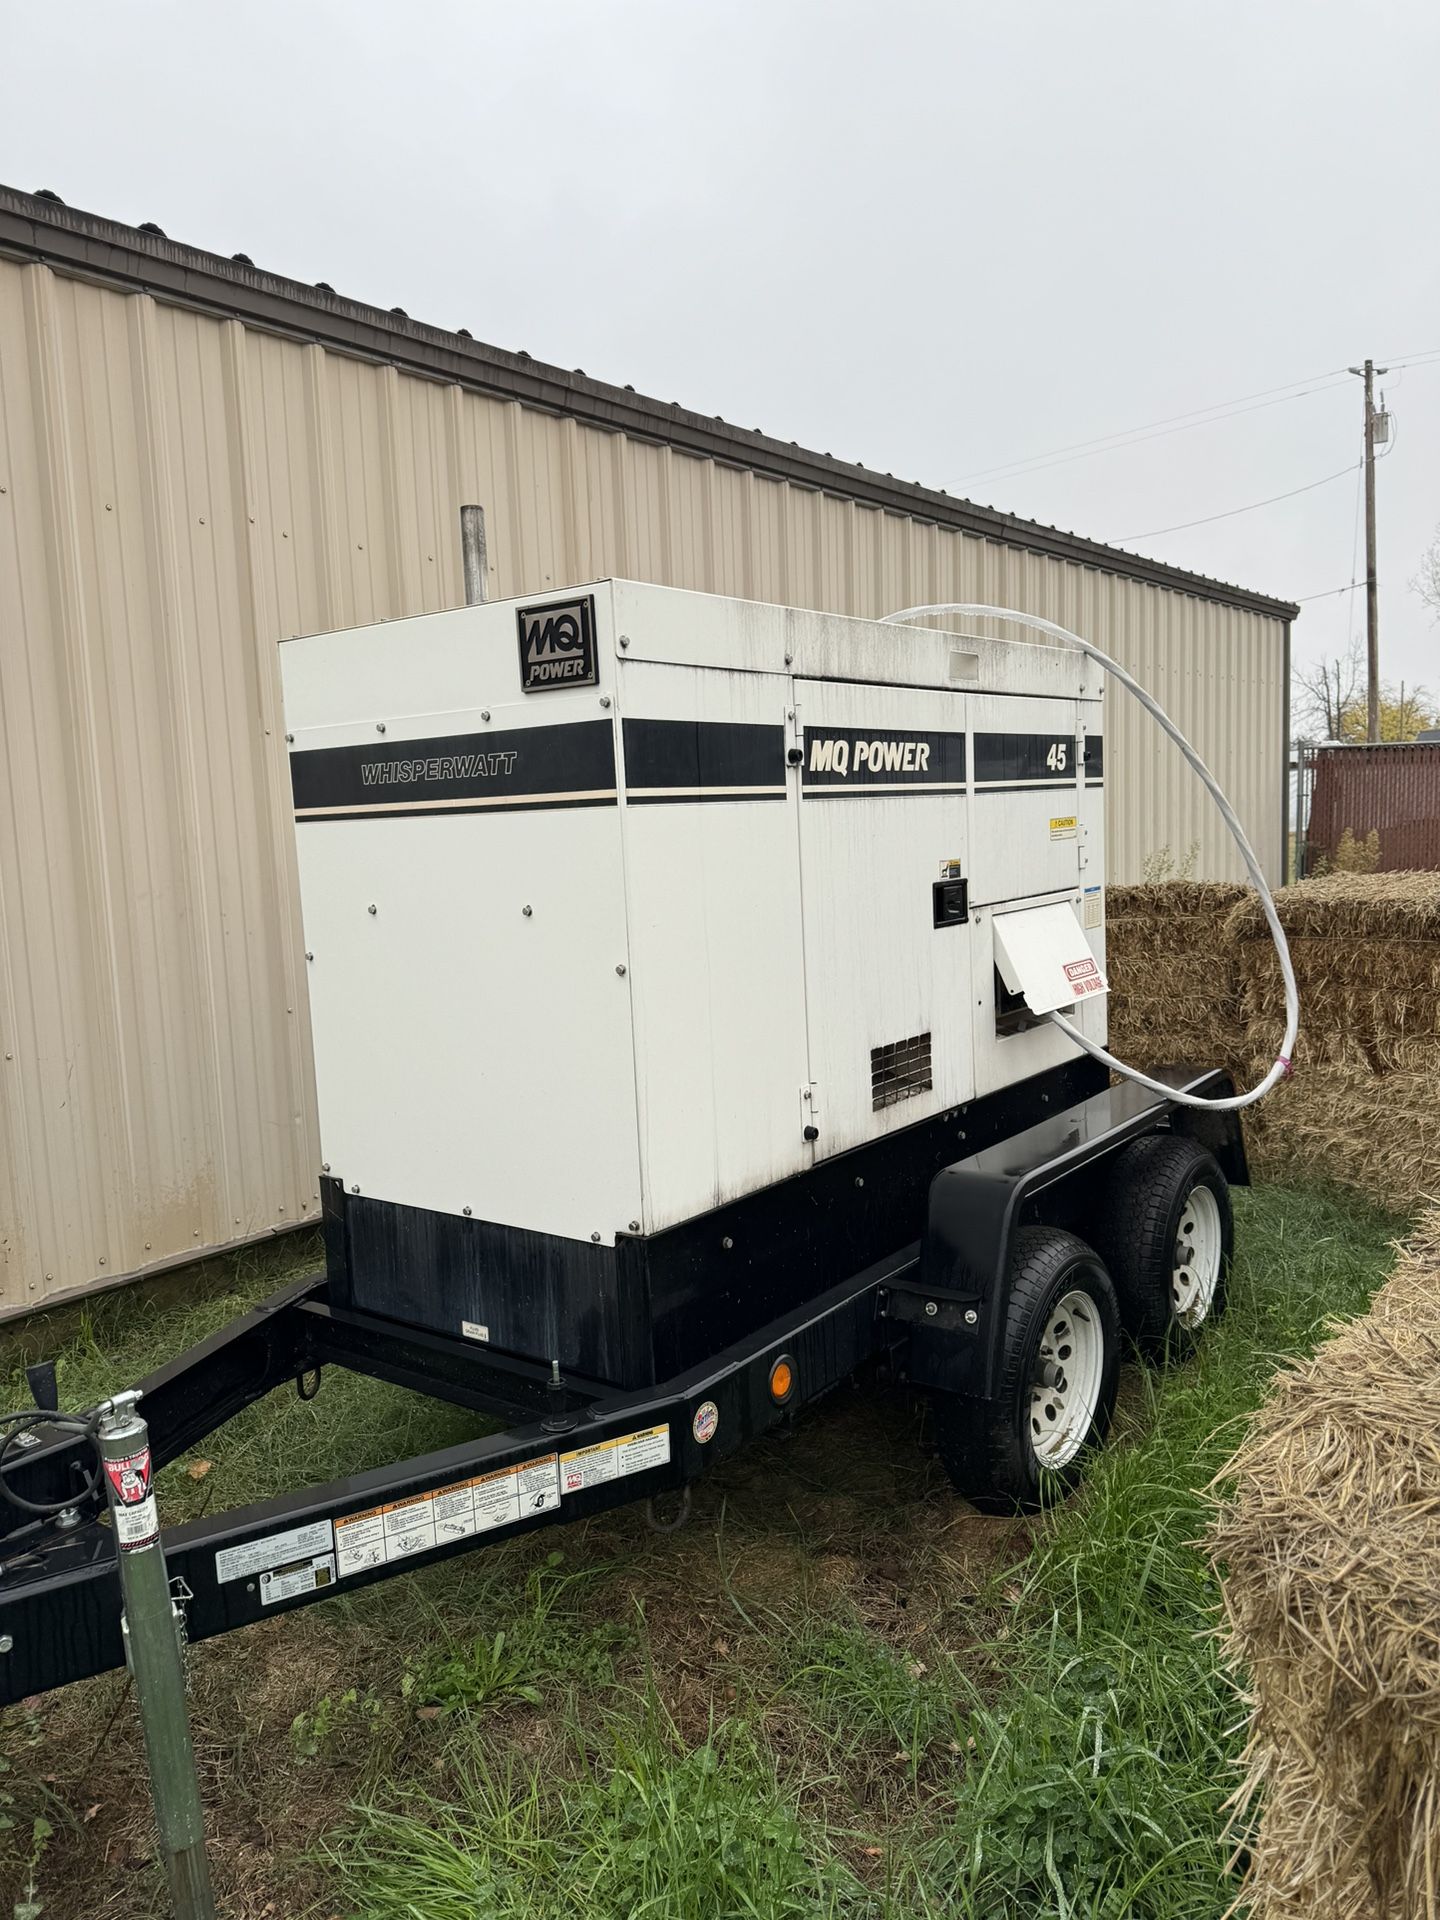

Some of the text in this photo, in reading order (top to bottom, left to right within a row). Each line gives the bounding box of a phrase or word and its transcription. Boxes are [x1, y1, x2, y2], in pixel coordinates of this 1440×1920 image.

[521, 612, 585, 656] MQ
[530, 660, 585, 681] POWER
[809, 740, 930, 777] MQ POWER
[1046, 743, 1067, 771] 45
[361, 751, 518, 785] WHISPERWATT
[1058, 819, 1074, 827] CAUTION
[1068, 963, 1094, 977] DANGER
[1072, 981, 1086, 995] HIGH
[576, 1446, 601, 1457] IMPORTANT
[526, 1457, 552, 1469] WARNING
[485, 1469, 512, 1481] WARNING
[443, 1482, 469, 1494] WARNING
[397, 1495, 425, 1508] WARNING
[349, 1510, 377, 1522] WARNING
